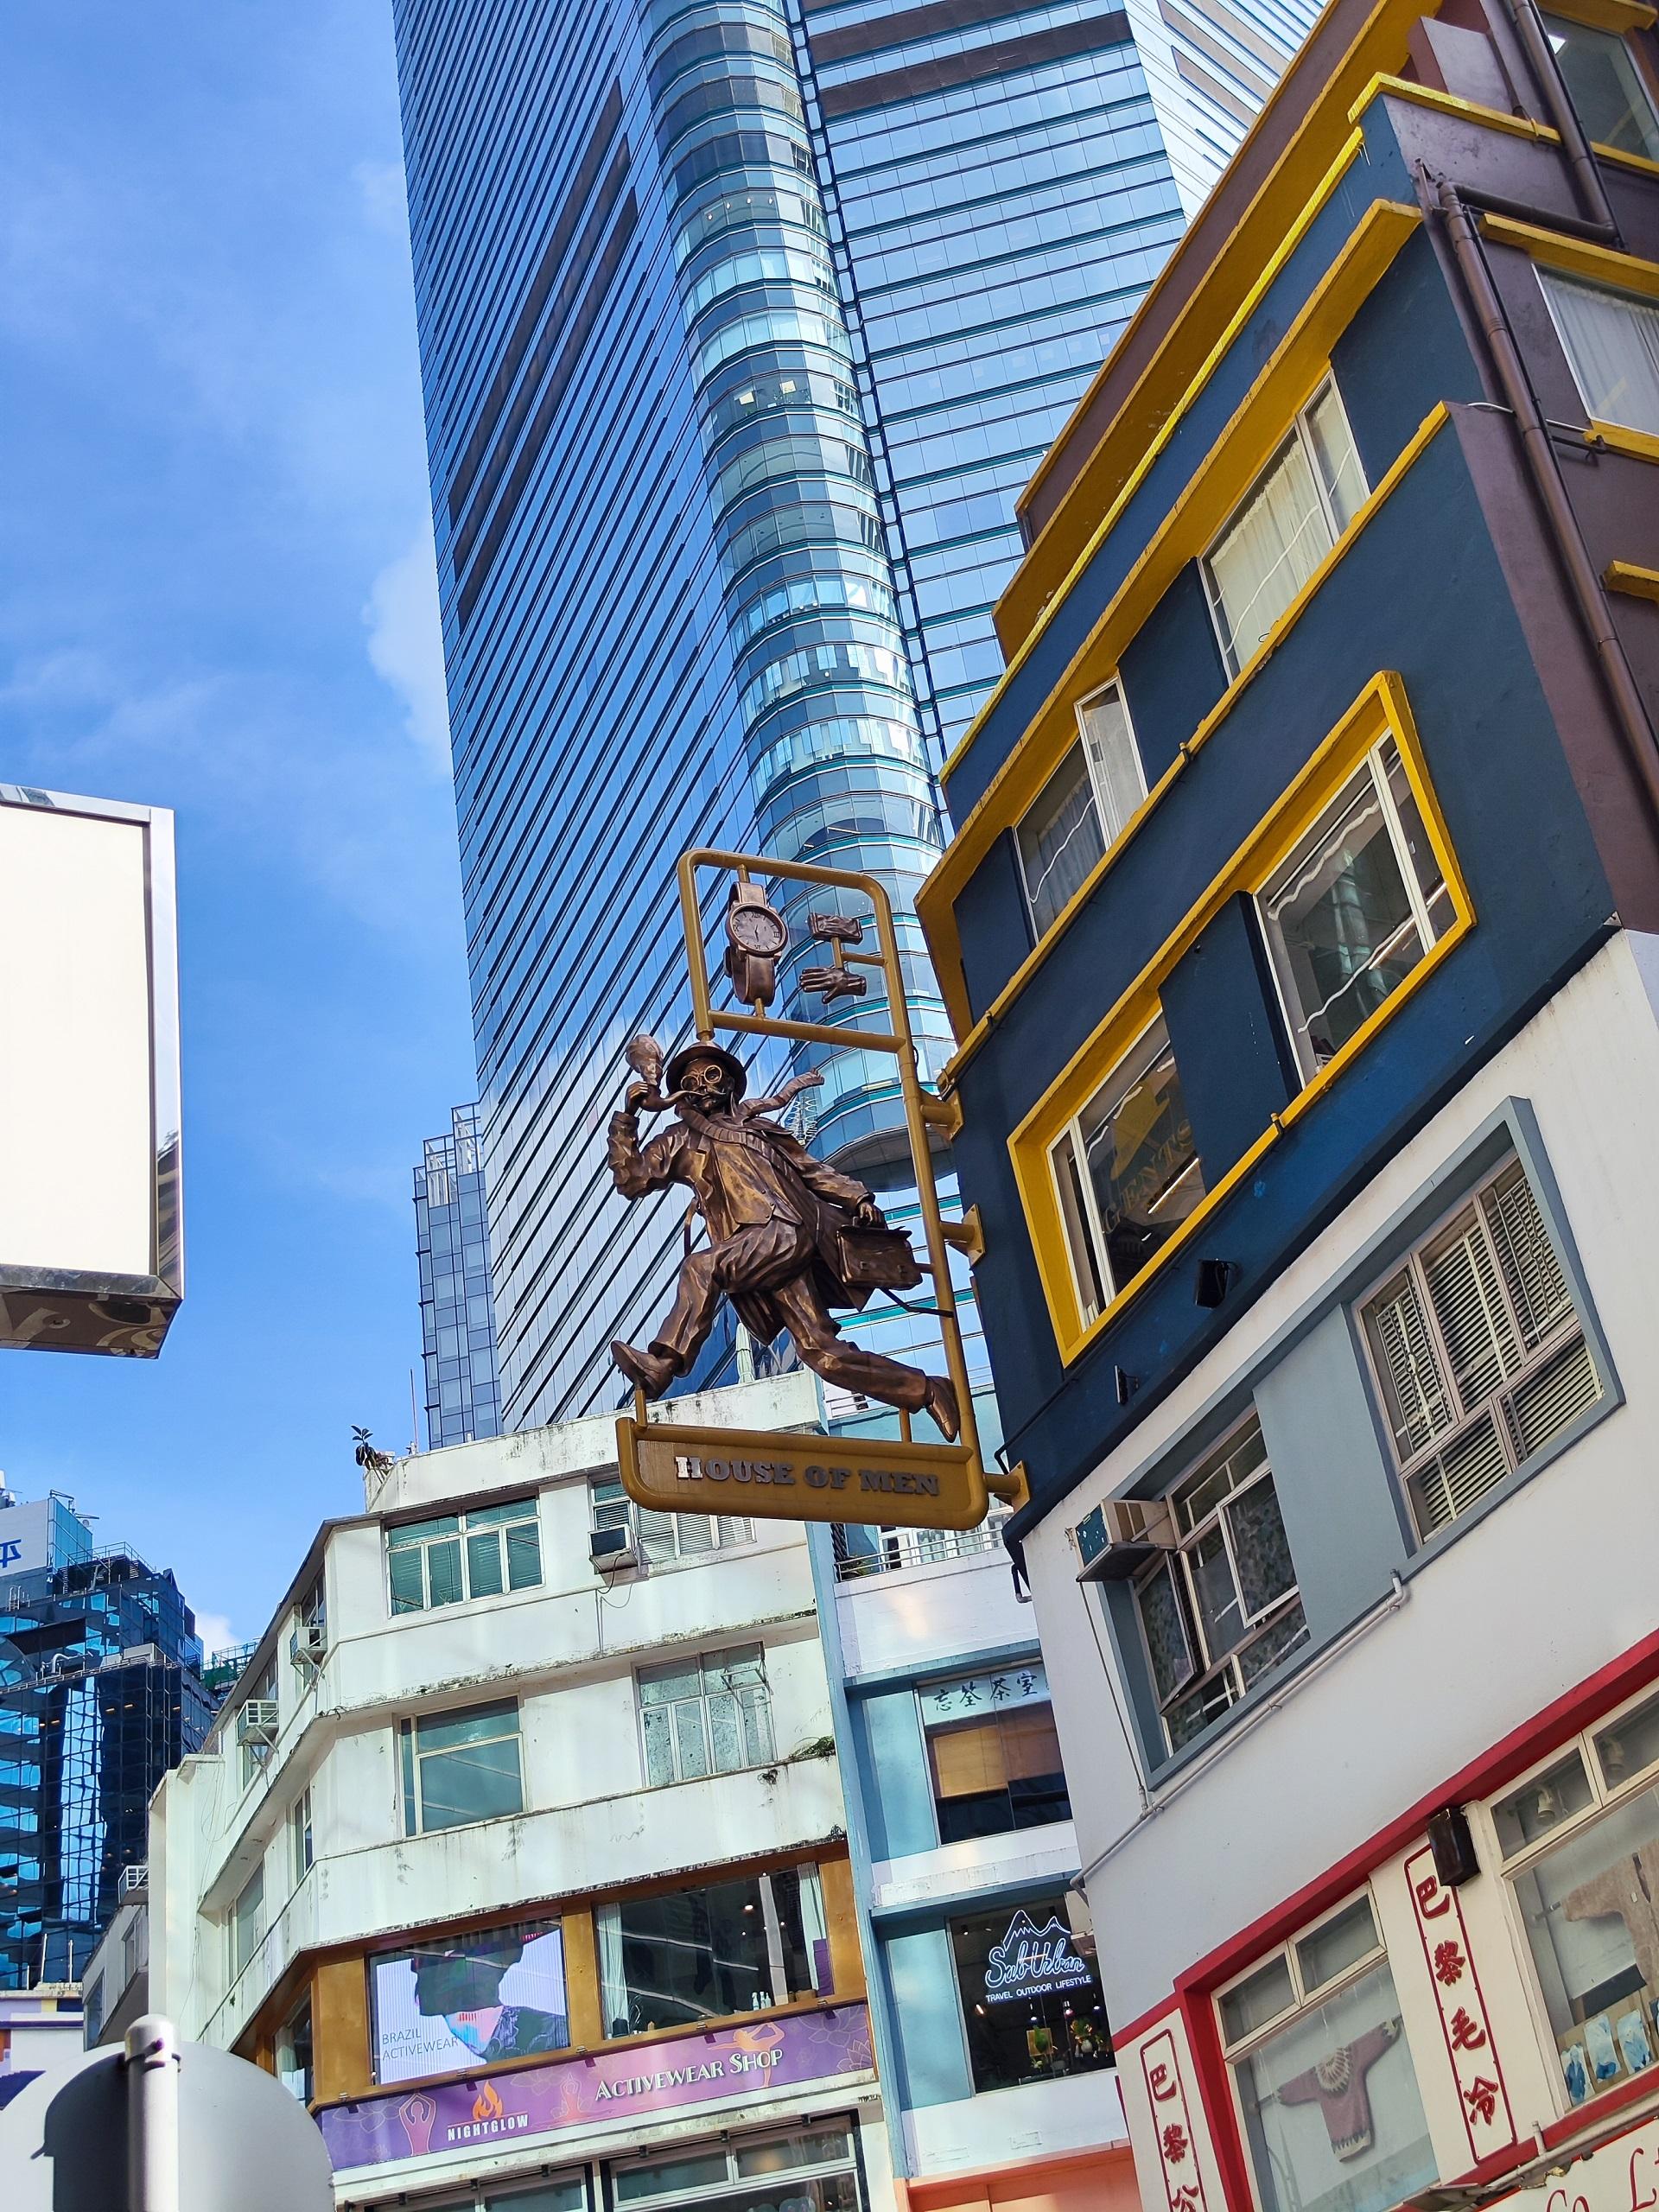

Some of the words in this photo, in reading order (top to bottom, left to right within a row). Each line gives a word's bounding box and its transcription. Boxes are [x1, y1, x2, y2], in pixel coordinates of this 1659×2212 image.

[675, 1455, 796, 1484] HOUSE
[804, 1465, 851, 1489] OF
[859, 1470, 941, 1497] MEN
[986, 1991, 1014, 2004] TRAVEL
[1015, 1982, 1052, 1997] OUTDOOR
[1055, 1974, 1092, 1989] LIFESTYLE
[1415, 1874, 1499, 2126] 巴黎毛冷
[382, 2028, 422, 2045] BRAZIL
[382, 2037, 459, 2061] ACTIVEWEAR
[448, 2114, 529, 2141] NIGHTGLOW
